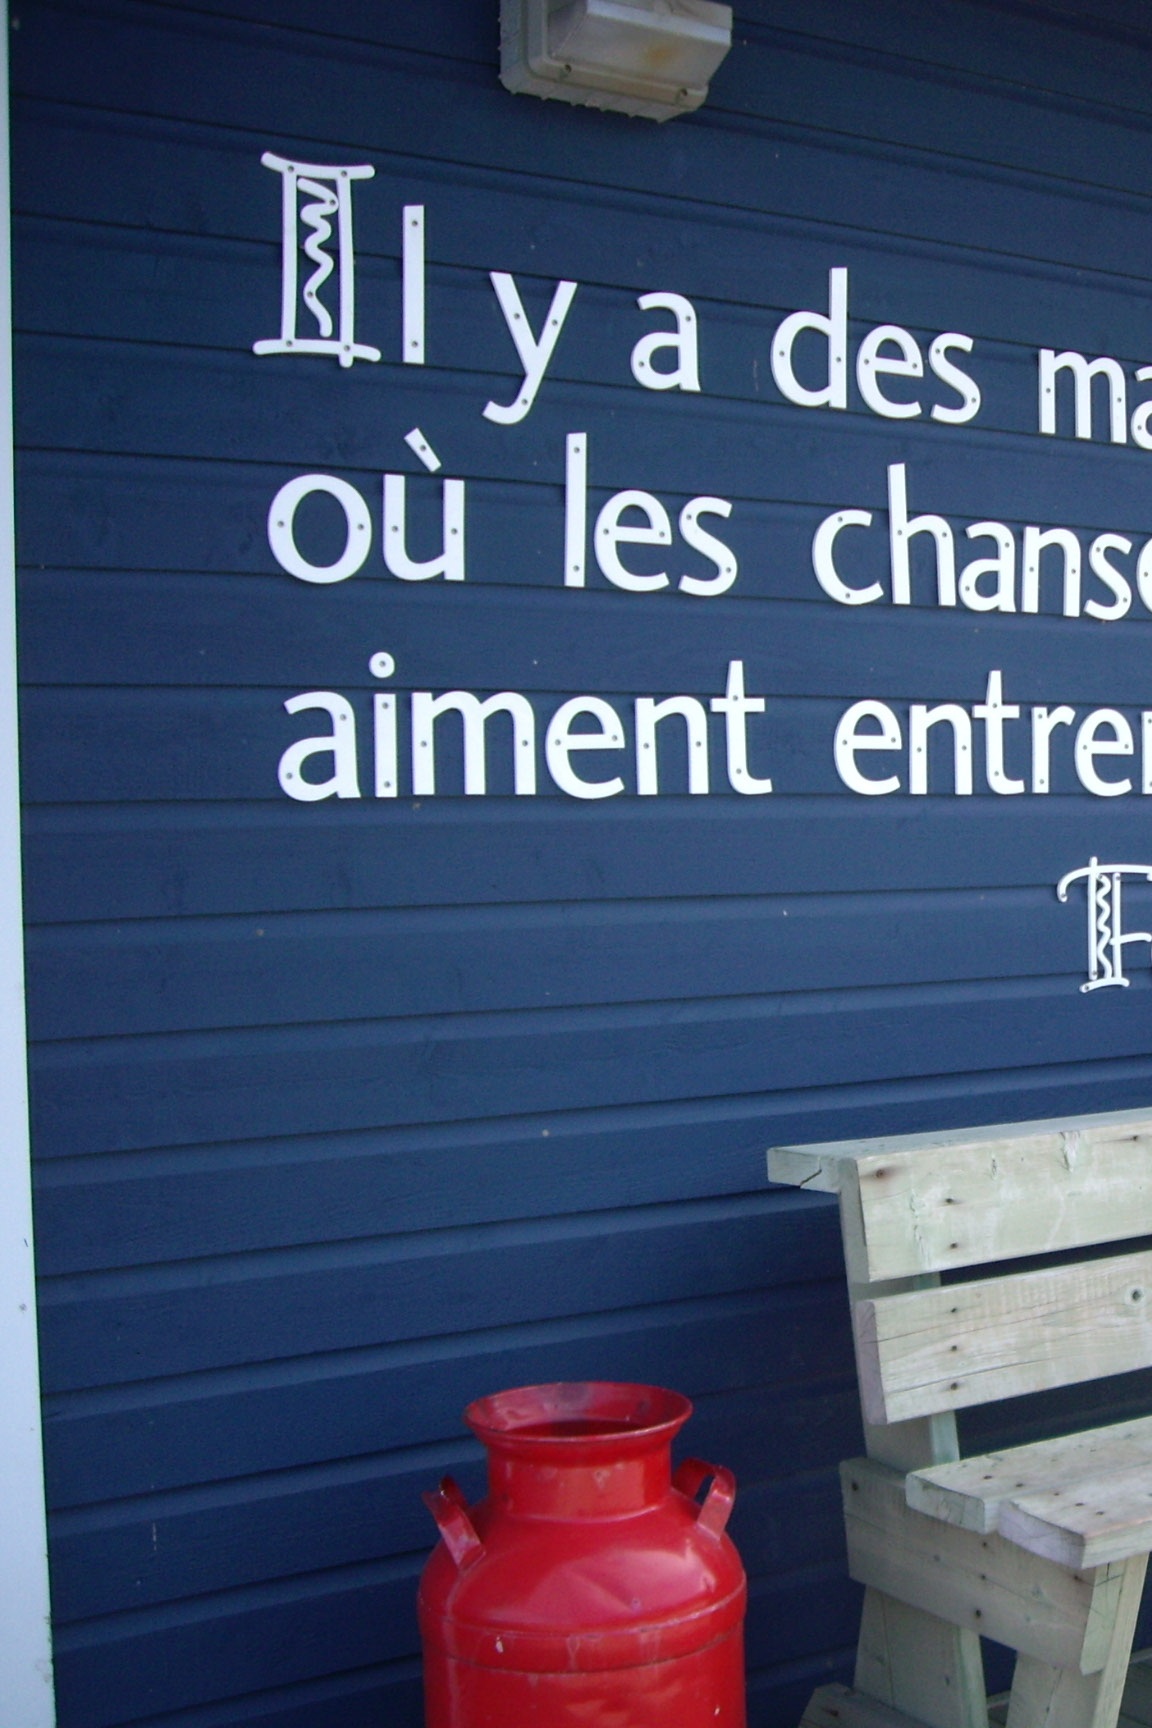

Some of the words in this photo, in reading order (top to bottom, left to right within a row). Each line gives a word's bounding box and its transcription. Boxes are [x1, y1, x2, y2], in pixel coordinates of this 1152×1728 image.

[253, 152, 424, 367] Il
[483, 272, 577, 426] y
[631, 292, 700, 391] a
[771, 267, 980, 424] des
[268, 428, 466, 583] où
[564, 433, 737, 596] les
[279, 652, 773, 803] aiment
